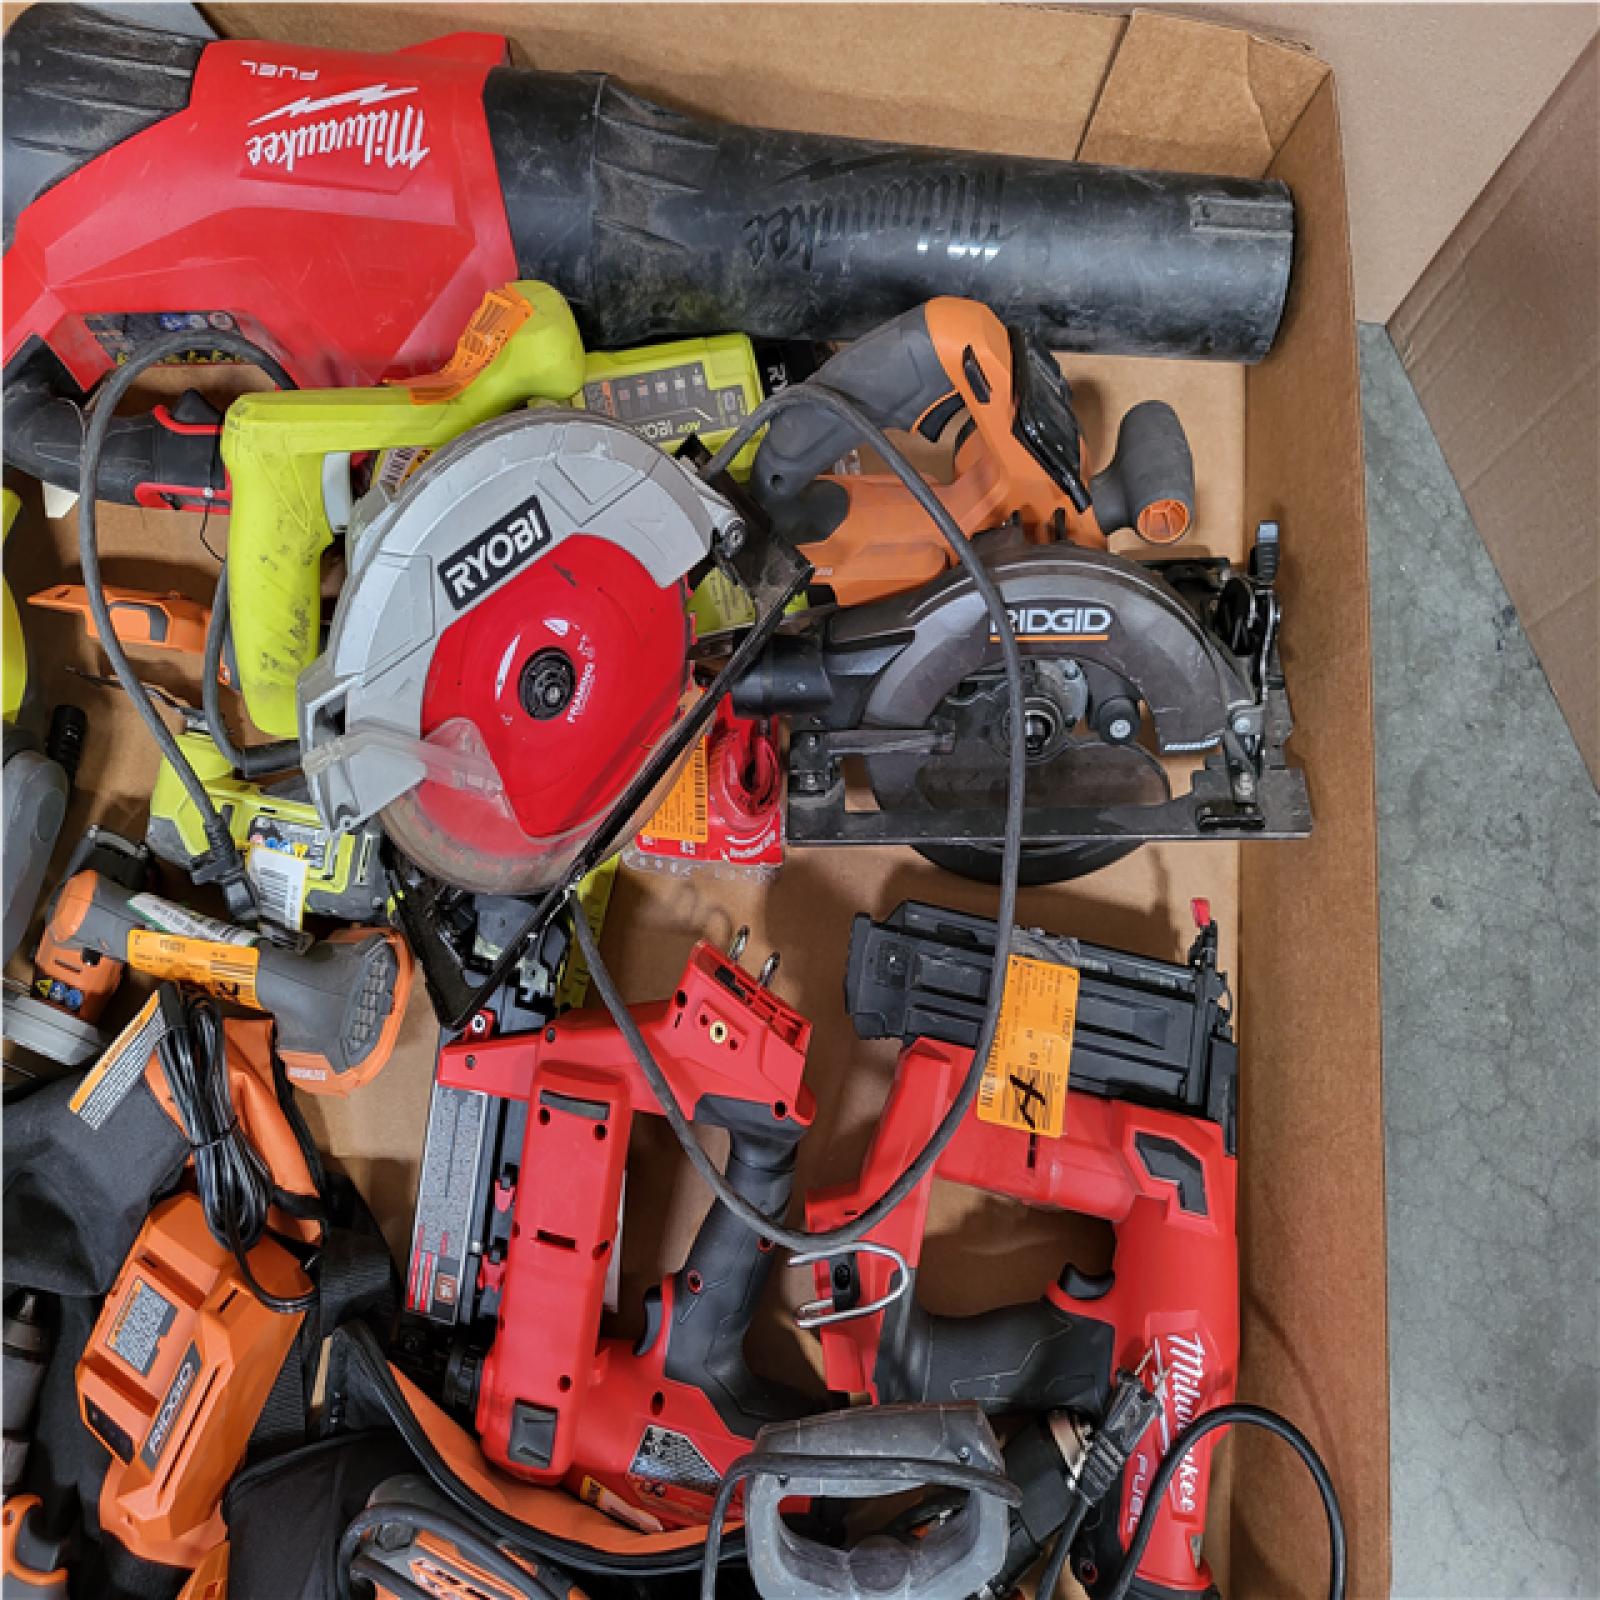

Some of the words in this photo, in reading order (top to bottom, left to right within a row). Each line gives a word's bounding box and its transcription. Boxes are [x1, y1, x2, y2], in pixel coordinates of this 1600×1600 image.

[240, 59, 319, 80] FUEL
[245, 104, 430, 172] Milwaukee
[742, 168, 1022, 272] Milwaukee
[445, 508, 544, 599] RYOBI
[1127, 1453, 1149, 1534] FUEL
